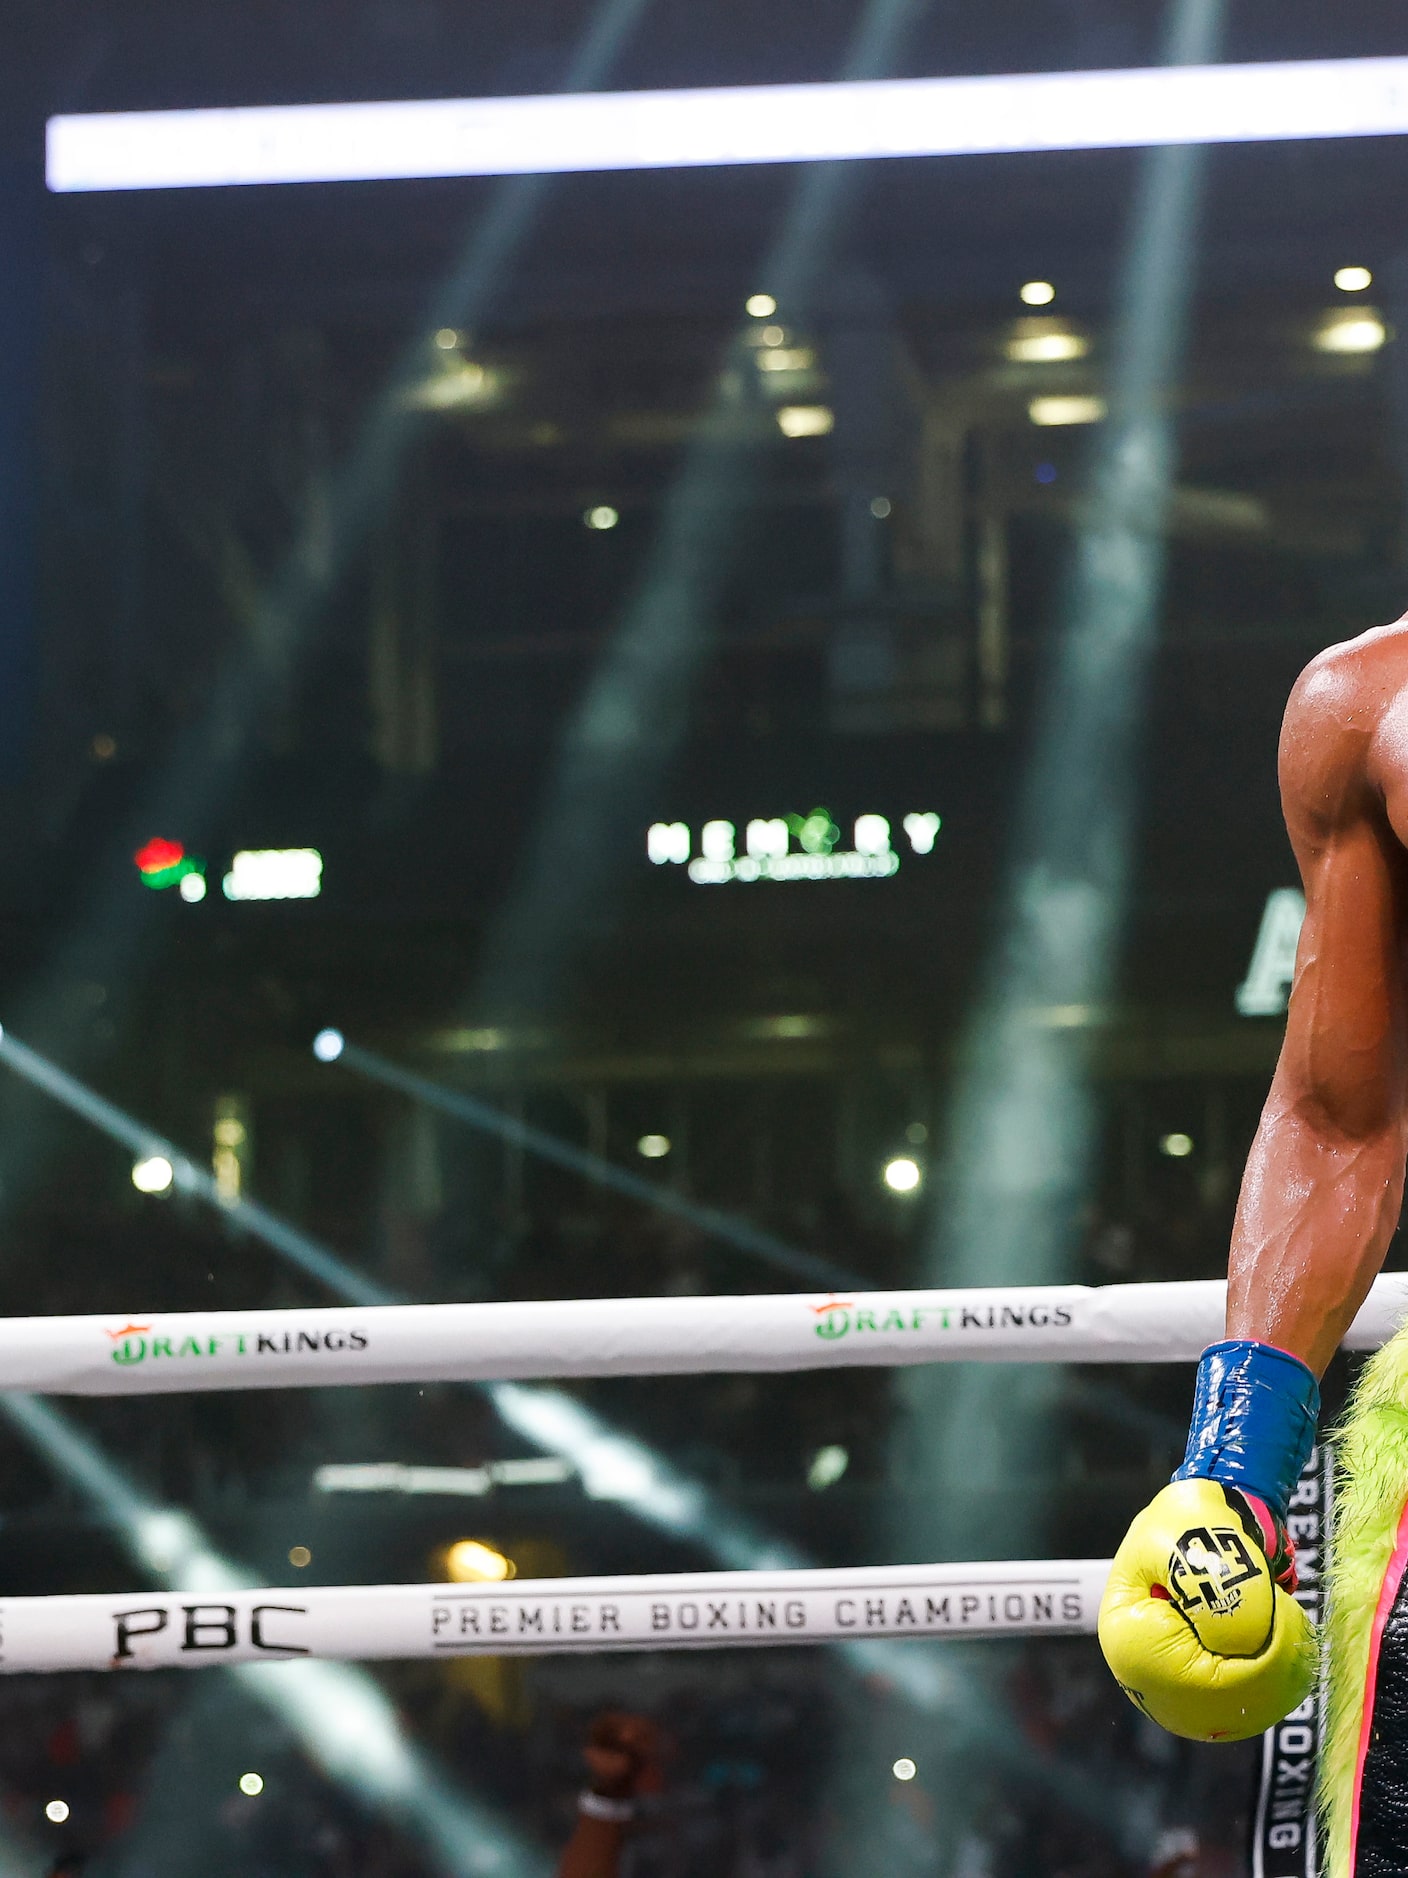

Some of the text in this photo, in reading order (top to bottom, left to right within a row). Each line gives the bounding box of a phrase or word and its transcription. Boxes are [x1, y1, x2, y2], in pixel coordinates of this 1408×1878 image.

[814, 1303, 1073, 1340] DRAFTKINGS
[112, 1328, 370, 1366] DRAFTKINGS
[112, 1604, 311, 1659] PBC
[431, 1593, 1084, 1635] PREMIER BOXING CHAMPIONS
